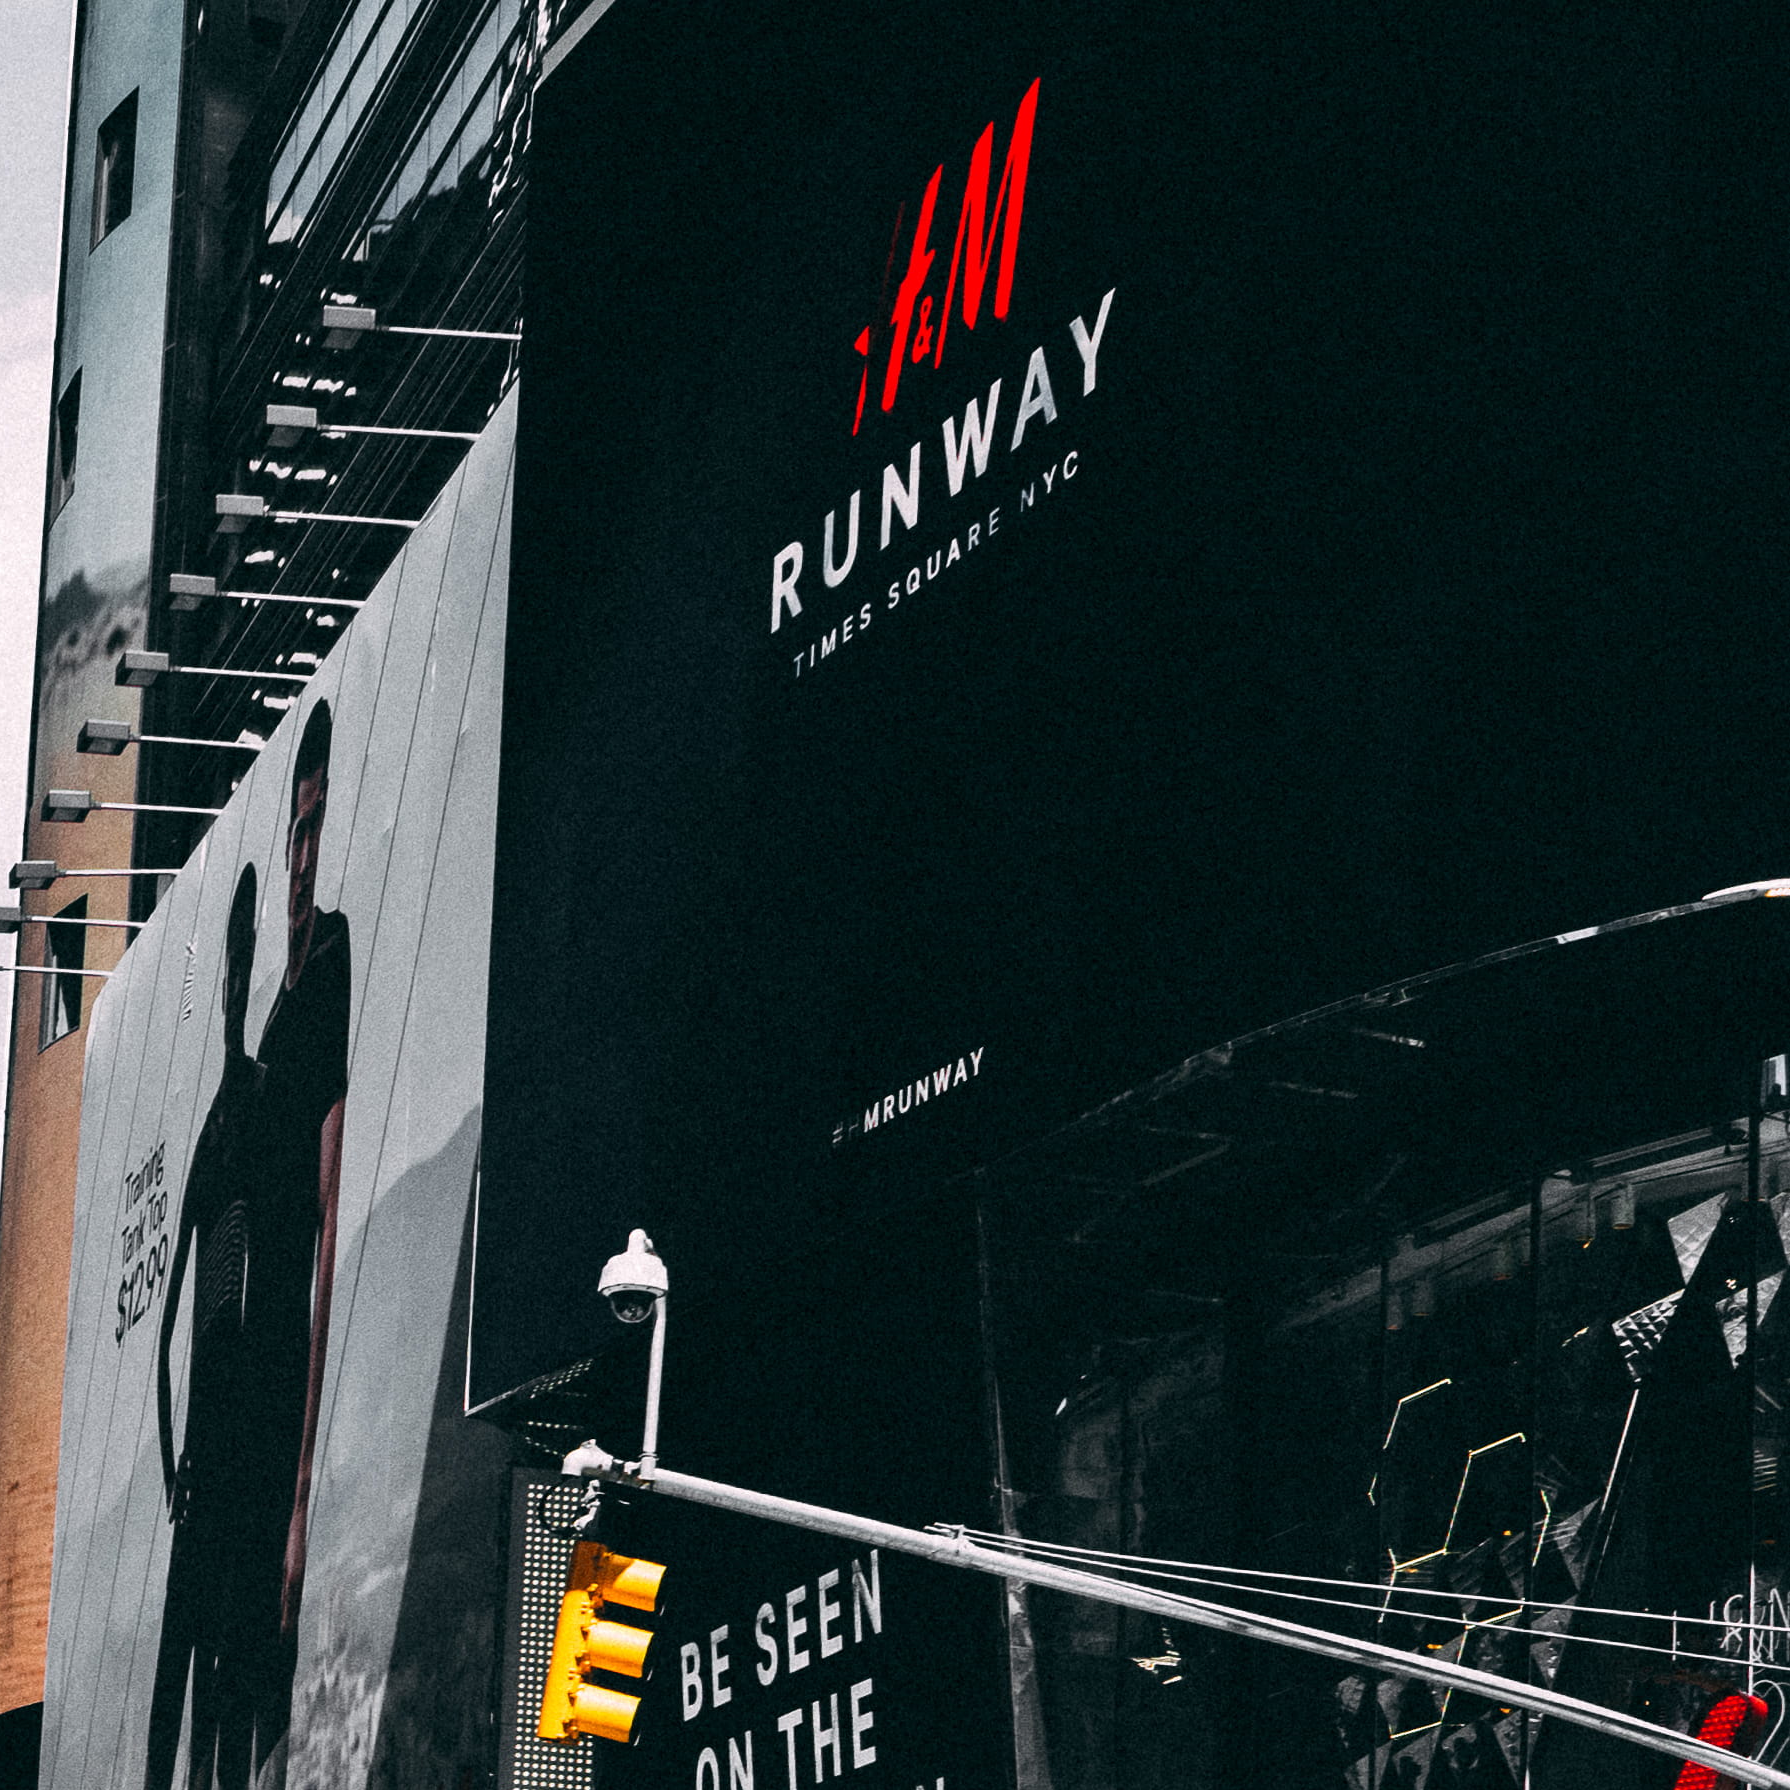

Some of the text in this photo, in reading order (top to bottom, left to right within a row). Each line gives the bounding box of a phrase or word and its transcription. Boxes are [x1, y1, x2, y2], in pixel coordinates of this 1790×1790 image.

[769, 287, 1116, 633] RUNWAY
[794, 450, 1081, 678] TIMES SQUARE NYC
[121, 1190, 167, 1266] Tank Top
[124, 1140, 166, 1215] Training
[679, 1549, 885, 1724] BE SEEN
